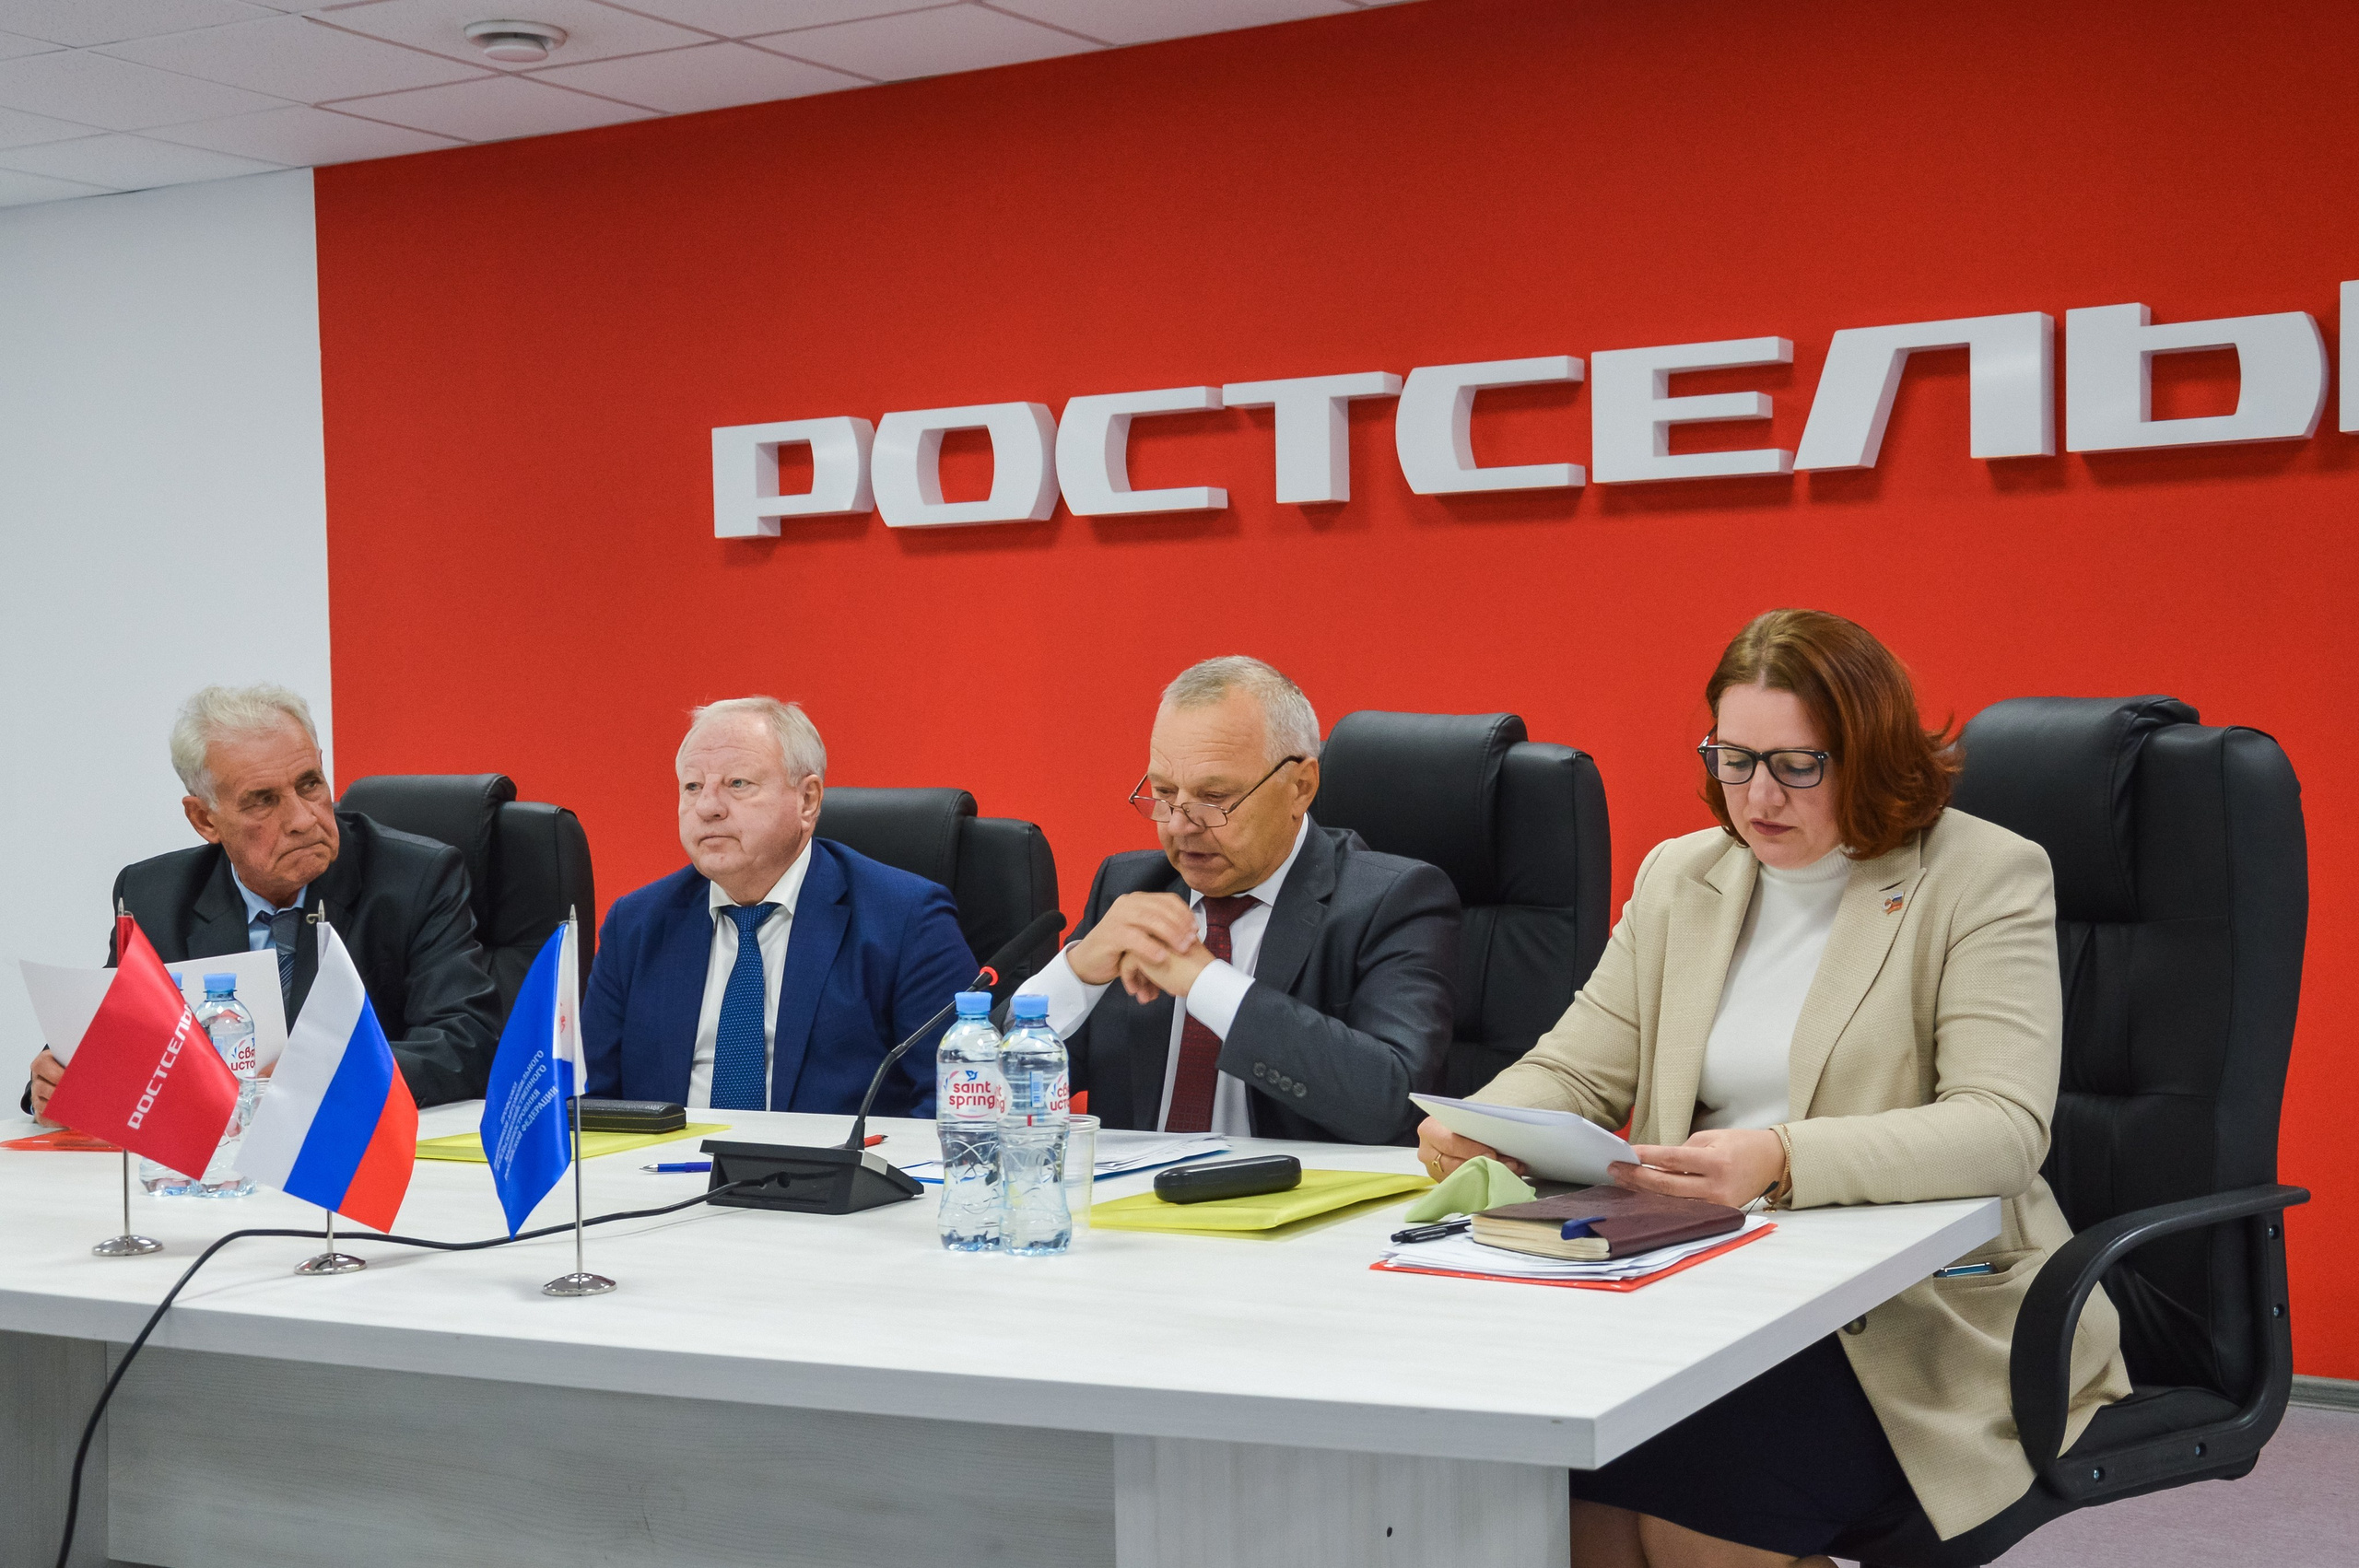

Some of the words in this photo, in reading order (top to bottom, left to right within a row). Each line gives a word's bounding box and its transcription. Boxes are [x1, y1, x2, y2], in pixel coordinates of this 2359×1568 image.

[710, 279, 2359, 539] РОСТСЕЛЬ
[127, 1003, 193, 1130] РОСТСЕЛЬ
[948, 1094, 995, 1110] spring
[953, 1081, 992, 1094] saint
